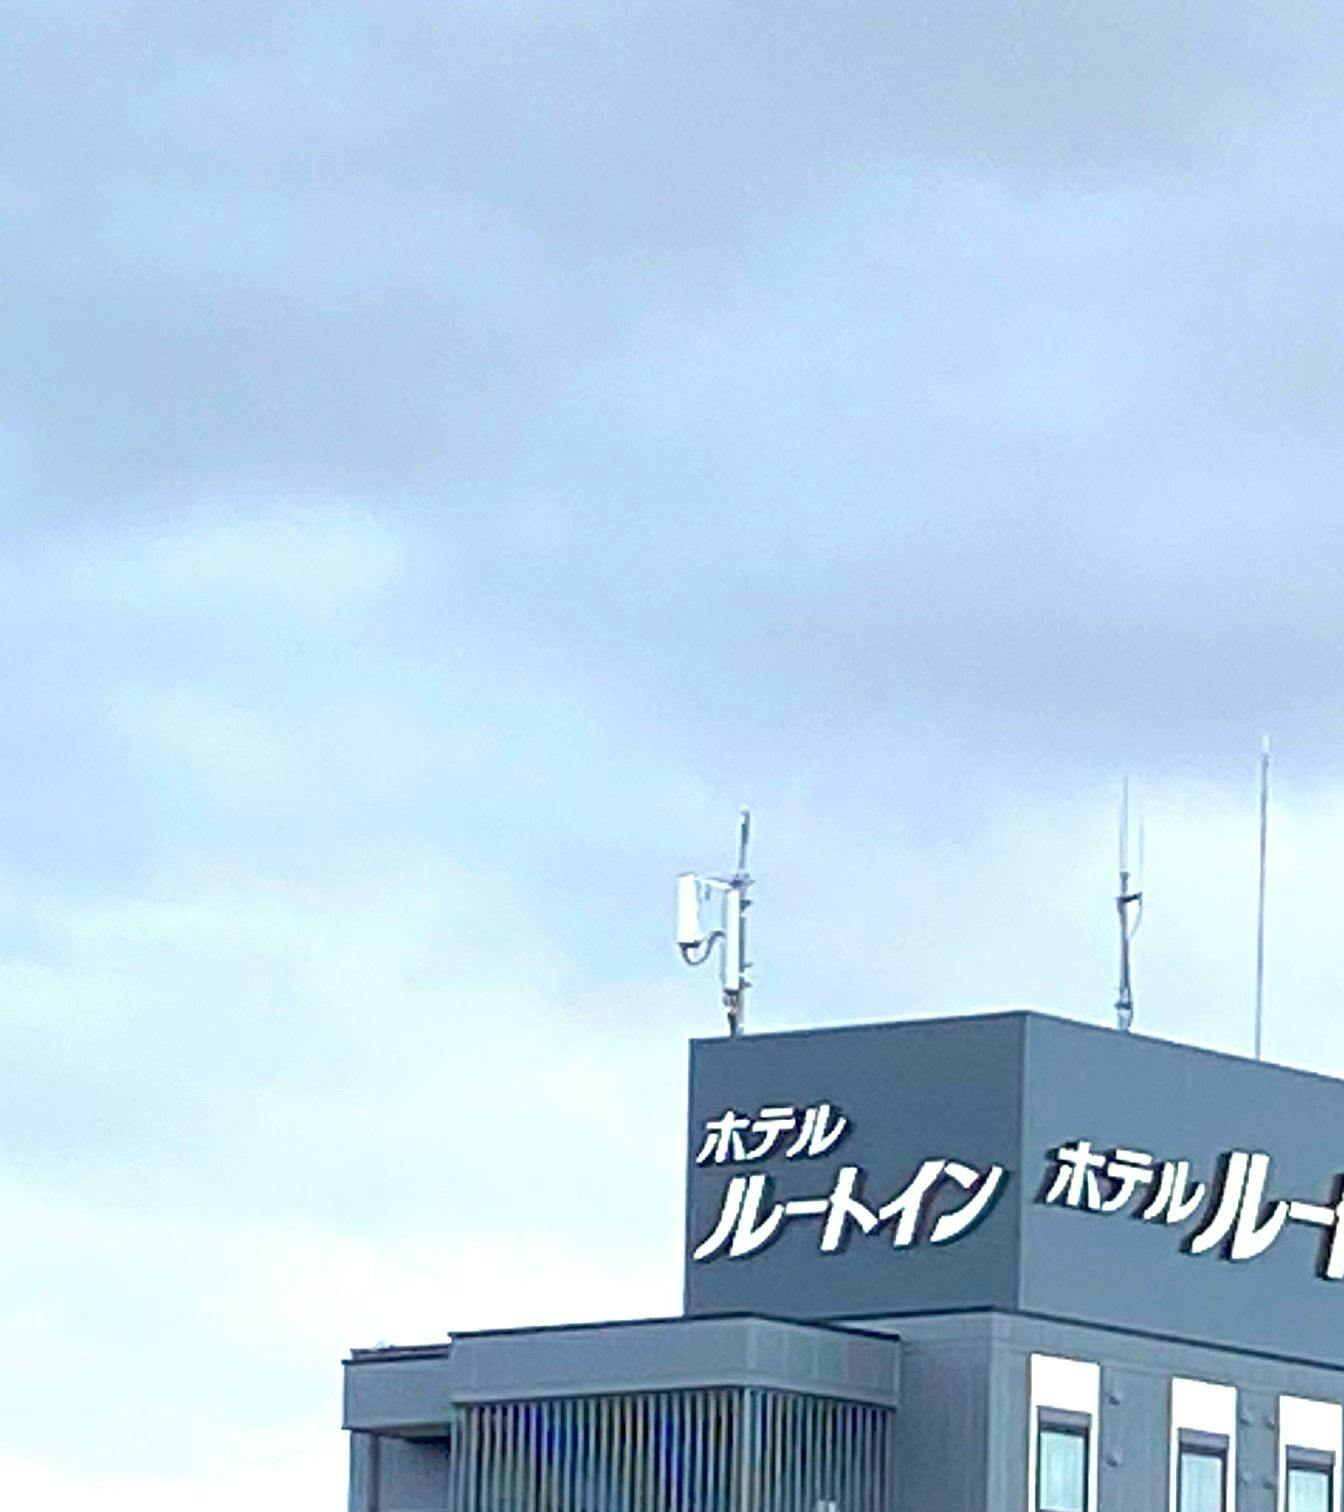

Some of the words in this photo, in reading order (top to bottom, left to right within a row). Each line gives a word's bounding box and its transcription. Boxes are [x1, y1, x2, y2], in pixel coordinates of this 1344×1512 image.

[696, 1104, 846, 1163] ホテル
[693, 1160, 1003, 1260] ルートイン
